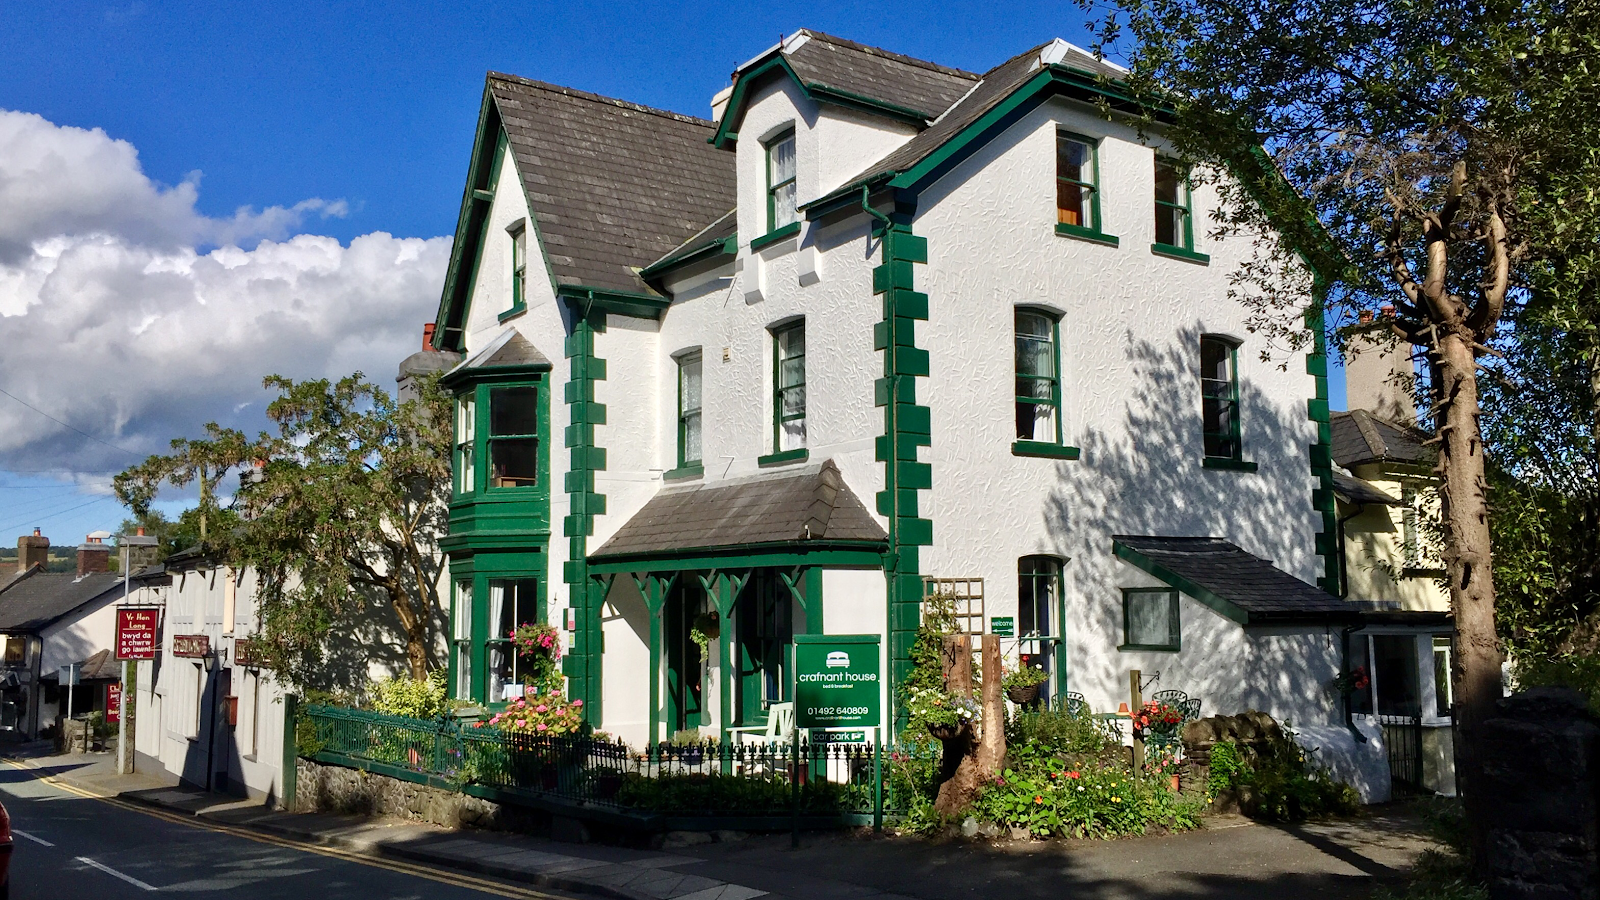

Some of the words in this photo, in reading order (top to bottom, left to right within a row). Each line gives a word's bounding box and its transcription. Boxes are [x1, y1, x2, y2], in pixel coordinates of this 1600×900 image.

[129, 621, 146, 630] Long
[122, 632, 140, 640] bwyd
[799, 672, 843, 682] crafnant
[845, 672, 877, 681] house
[807, 707, 835, 715] 01492
[836, 706, 869, 715] 640809
[829, 731, 850, 741] park
